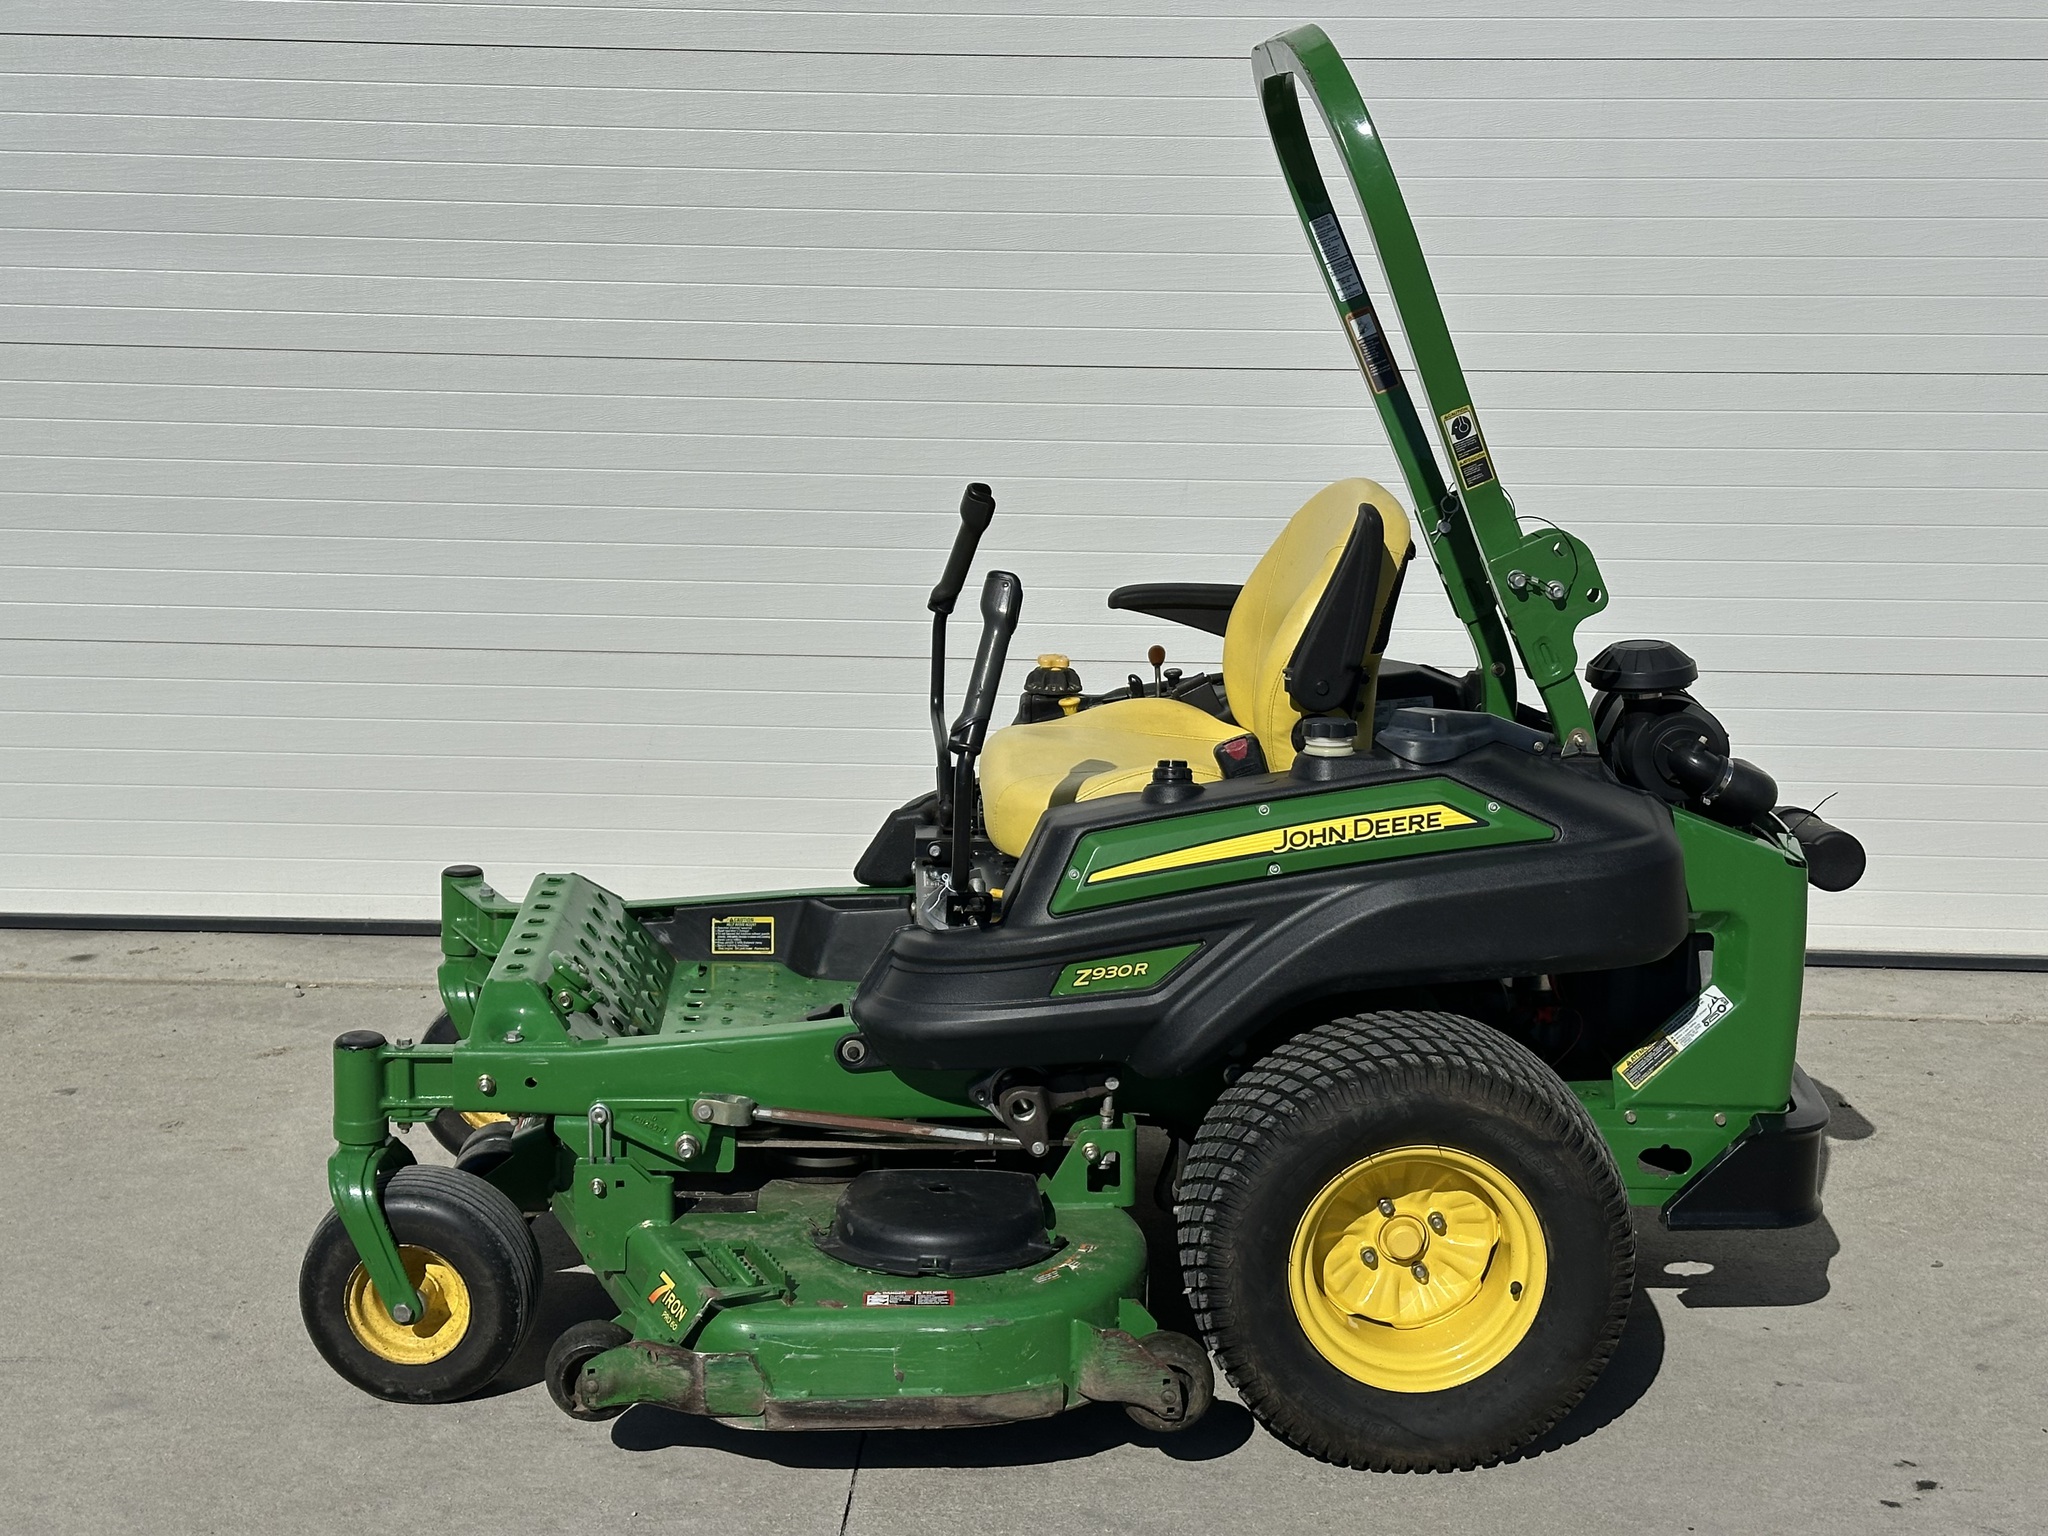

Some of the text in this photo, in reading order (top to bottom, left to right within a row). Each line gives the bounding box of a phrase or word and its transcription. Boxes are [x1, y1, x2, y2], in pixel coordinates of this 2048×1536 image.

[1274, 812, 1442, 850] JOHN DEERE
[1073, 962, 1149, 987] Z930R
[661, 1289, 688, 1322] IRON
